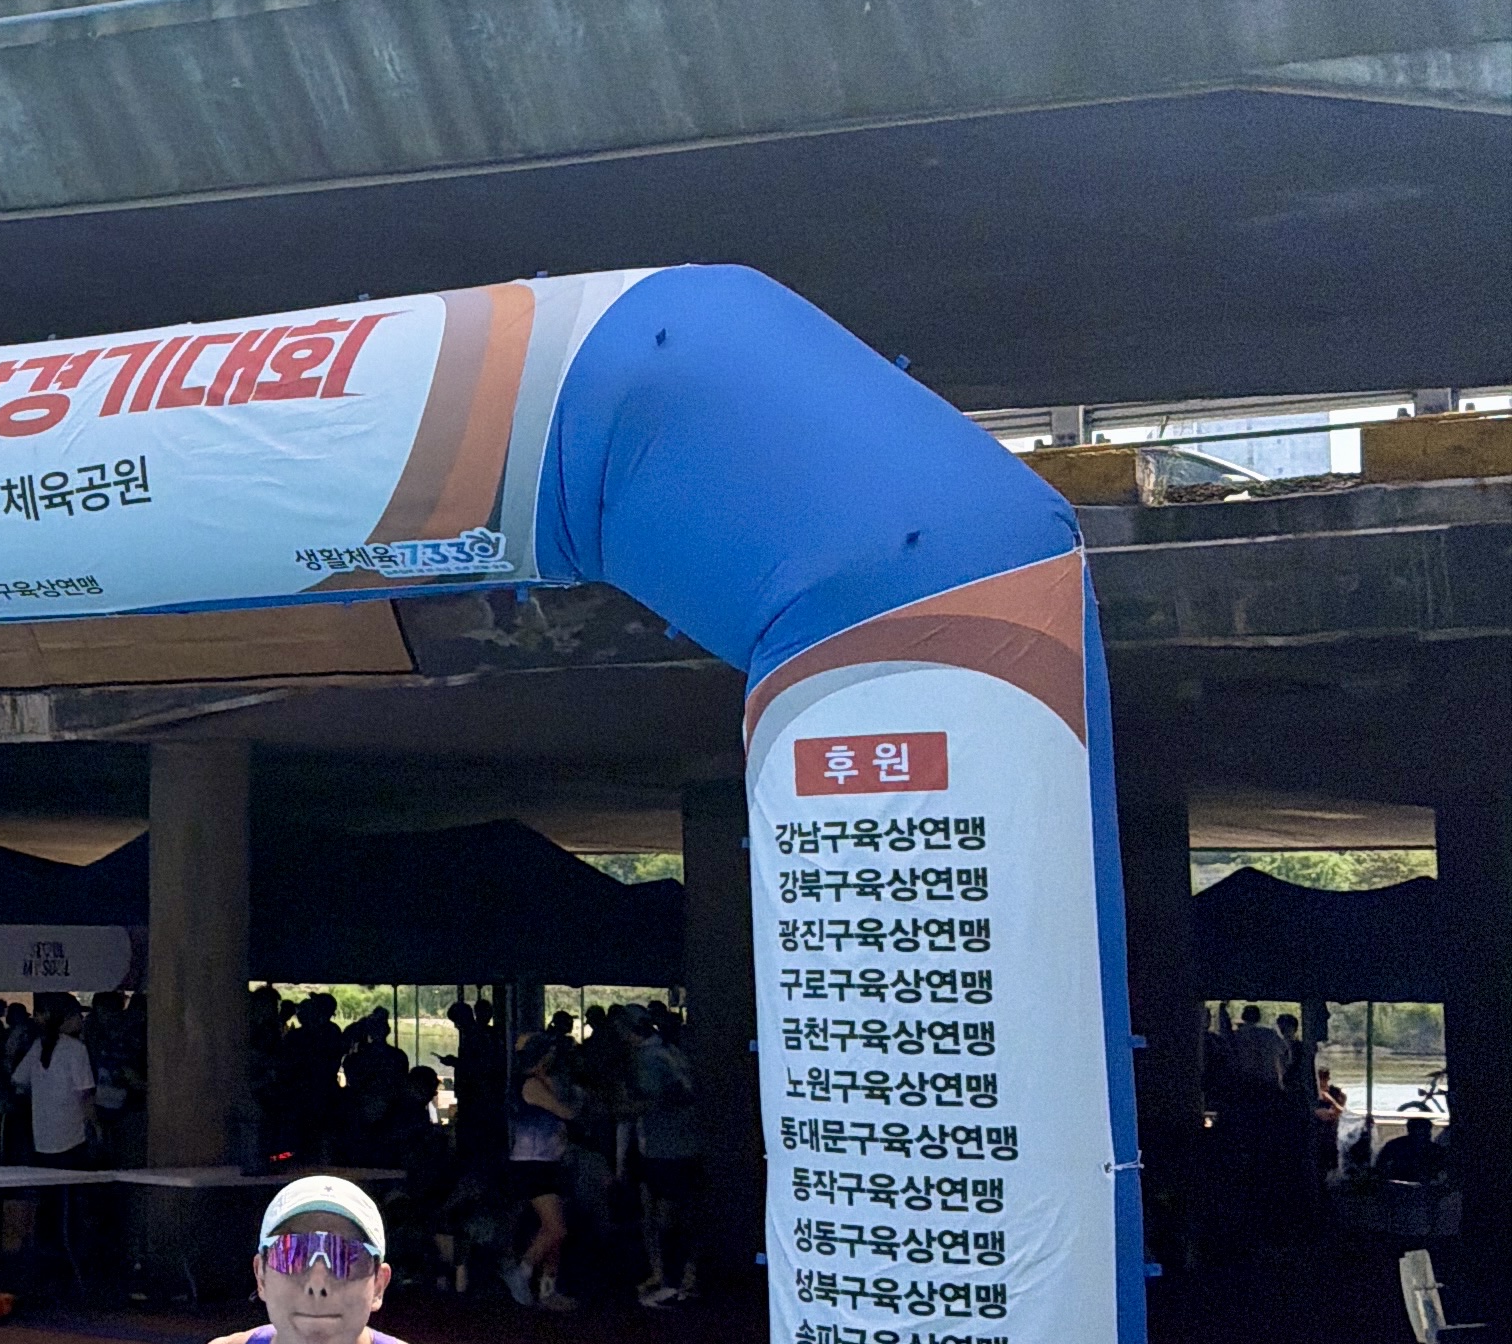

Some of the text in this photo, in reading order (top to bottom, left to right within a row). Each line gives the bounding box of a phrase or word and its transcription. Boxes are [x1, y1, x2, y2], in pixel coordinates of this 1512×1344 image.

[2, 455, 153, 523] 체육공원
[775, 816, 986, 855] 강남구육상연맹
[779, 866, 988, 904] 강북구육상연맹
[778, 918, 991, 952] 광진구육상연맹
[779, 968, 993, 1005] 구로구육상연맹
[782, 1017, 996, 1056] 금천구육상연맹
[786, 1066, 998, 1109] 노원구육상연맹
[780, 1116, 1019, 1161] 동대문구육상연맹
[792, 1167, 1004, 1214] 동작구육상연맹
[793, 1217, 1005, 1267] 성동구육상연맹
[795, 1268, 1007, 1320] 성북구육상연맹
